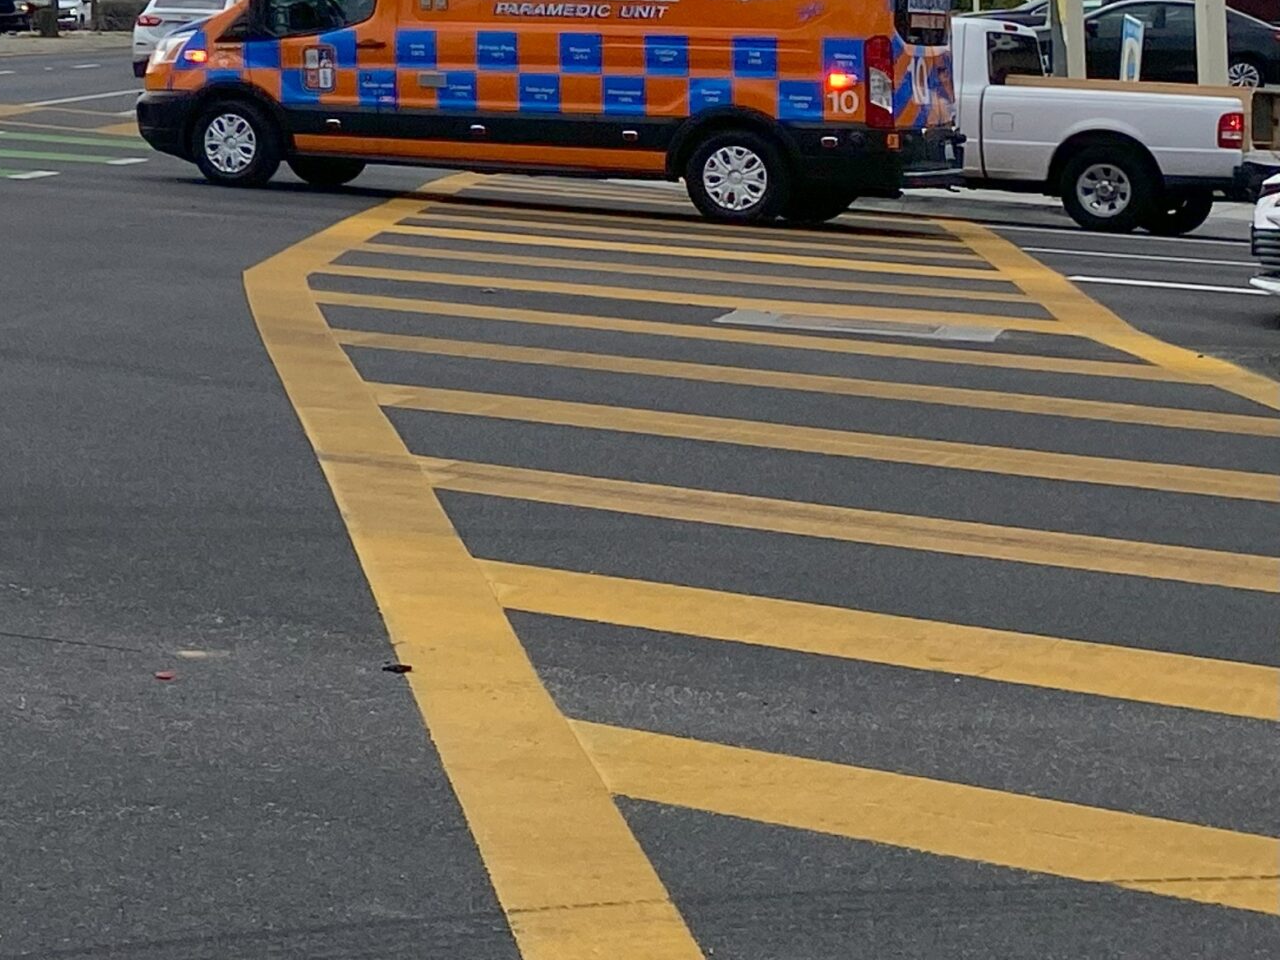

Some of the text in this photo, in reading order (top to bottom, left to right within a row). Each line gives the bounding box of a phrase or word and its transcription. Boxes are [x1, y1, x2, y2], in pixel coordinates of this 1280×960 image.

[494, 3, 668, 19] PARAMEDIC UNIT
[827, 90, 859, 115] 10
